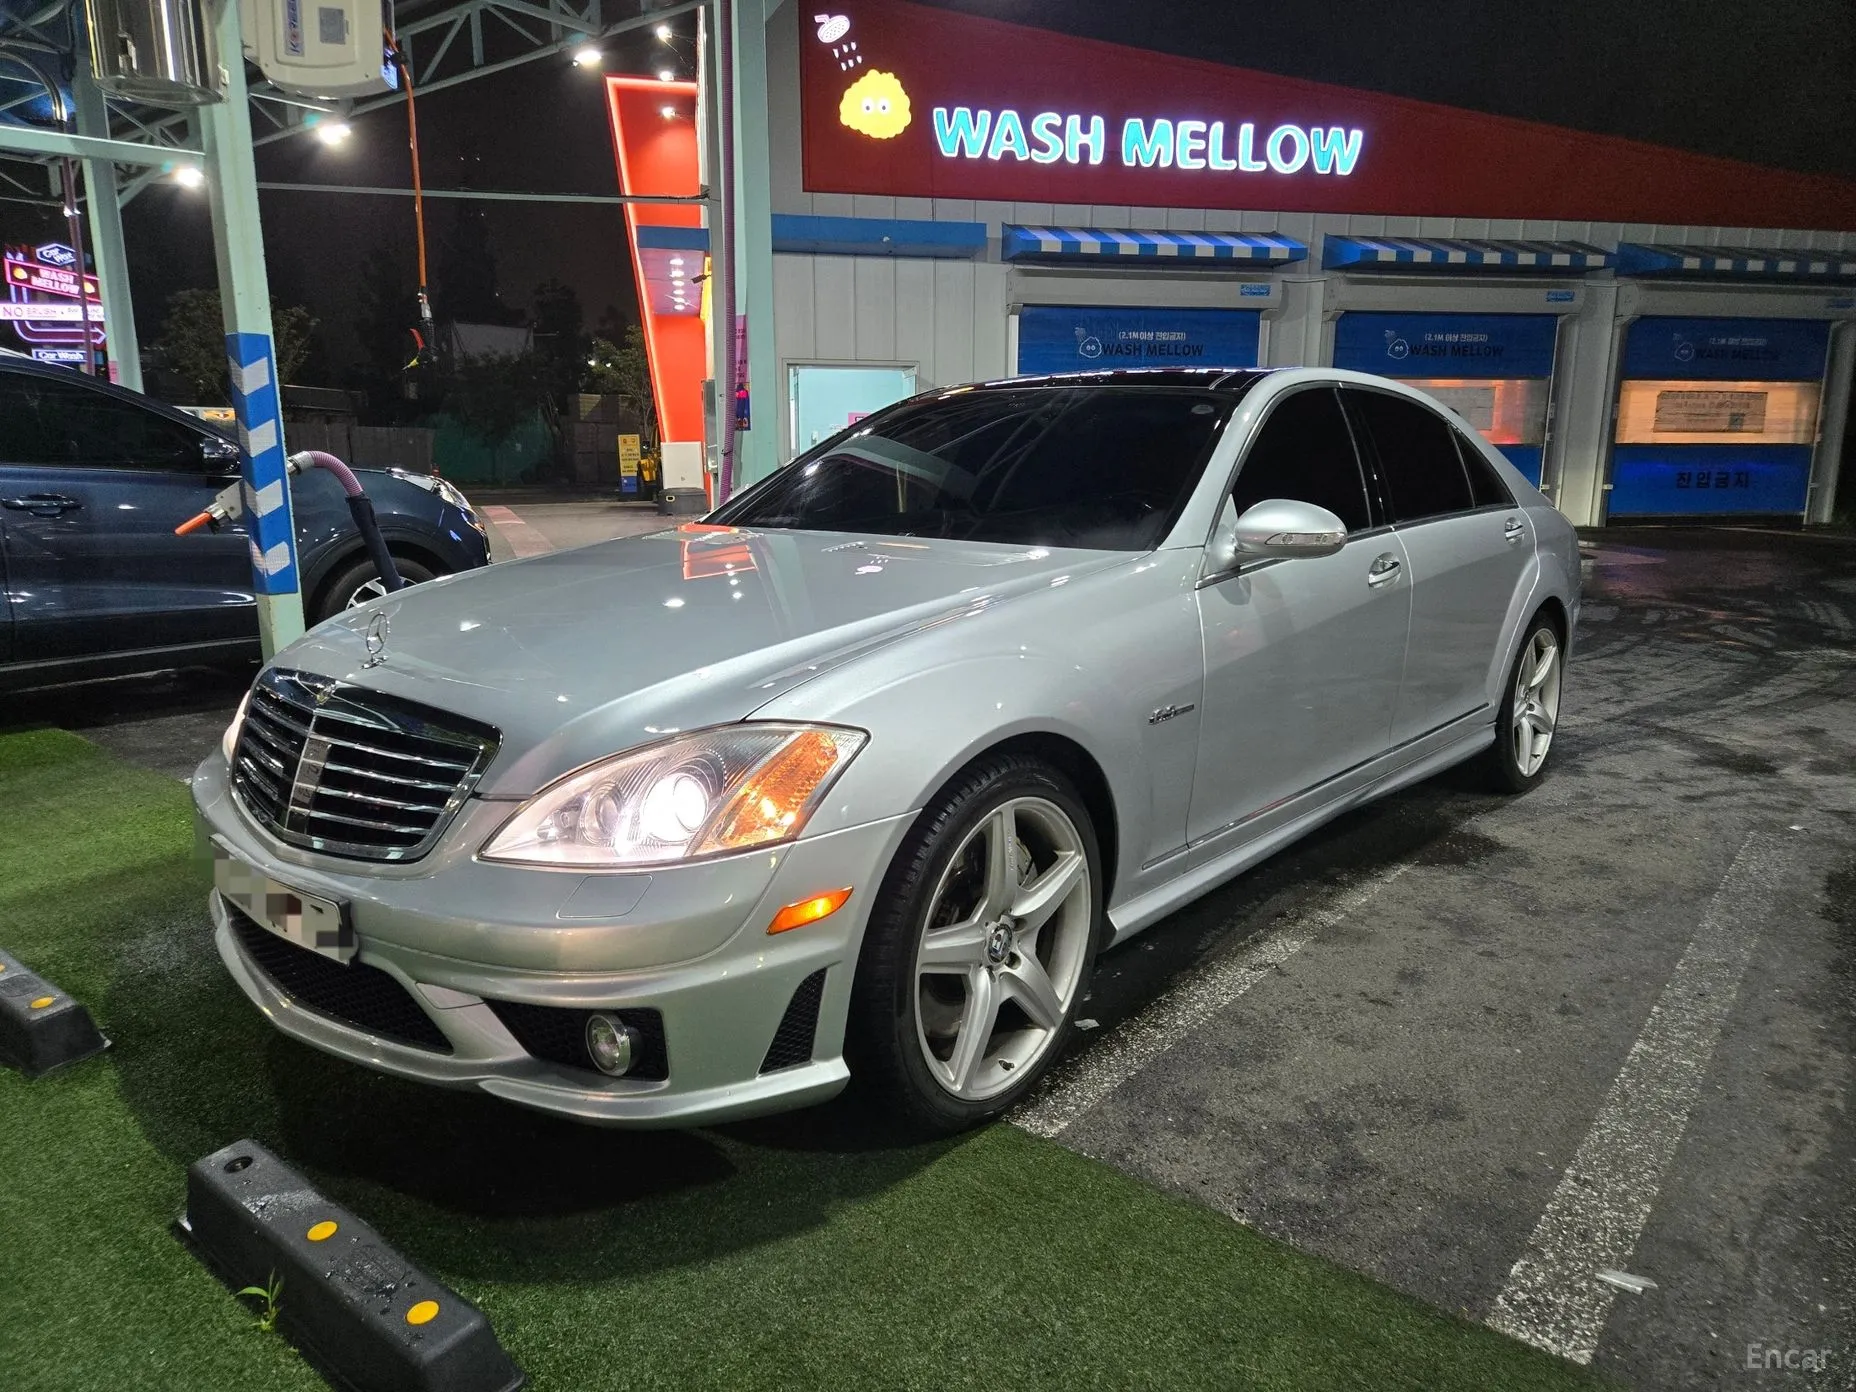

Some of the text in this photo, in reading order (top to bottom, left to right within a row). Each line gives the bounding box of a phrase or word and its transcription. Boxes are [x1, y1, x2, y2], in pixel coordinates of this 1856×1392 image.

[933, 106, 1364, 176] WASH MELLOW
[39, 268, 74, 284] WASH
[31, 275, 80, 295] MELLOW
[3, 306, 24, 318] NO
[38, 351, 84, 360] Car Wash
[1101, 343, 1204, 357] WASH MELLOW
[1410, 344, 1504, 358] WASH MELLOW
[1676, 471, 1749, 489] 진입금지
